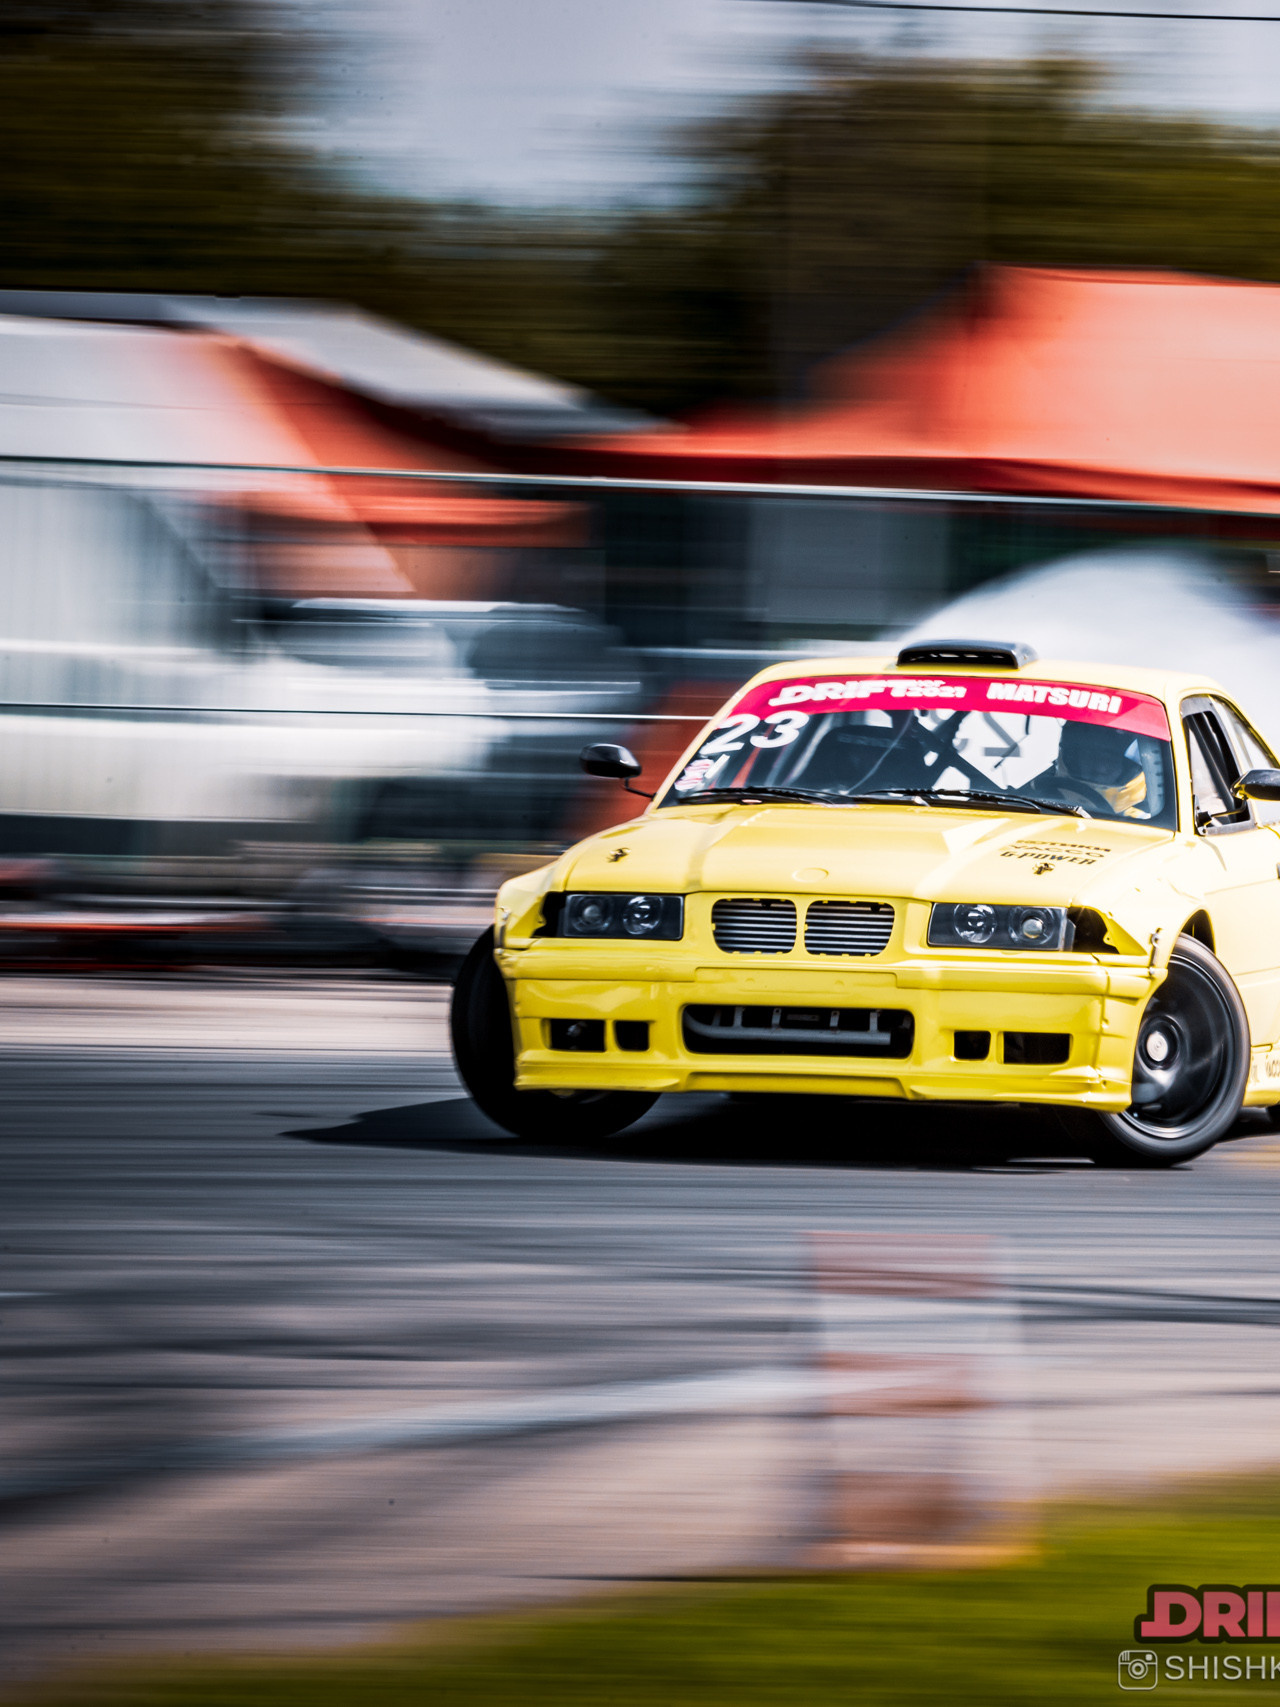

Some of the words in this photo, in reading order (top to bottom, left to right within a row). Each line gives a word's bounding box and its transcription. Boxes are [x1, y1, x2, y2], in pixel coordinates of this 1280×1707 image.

[768, 679, 917, 706] DRIFT
[904, 686, 967, 698] 2021
[986, 682, 1122, 714] MATSURI
[699, 710, 810, 755] 23
[1000, 851, 1096, 865] G-POWER
